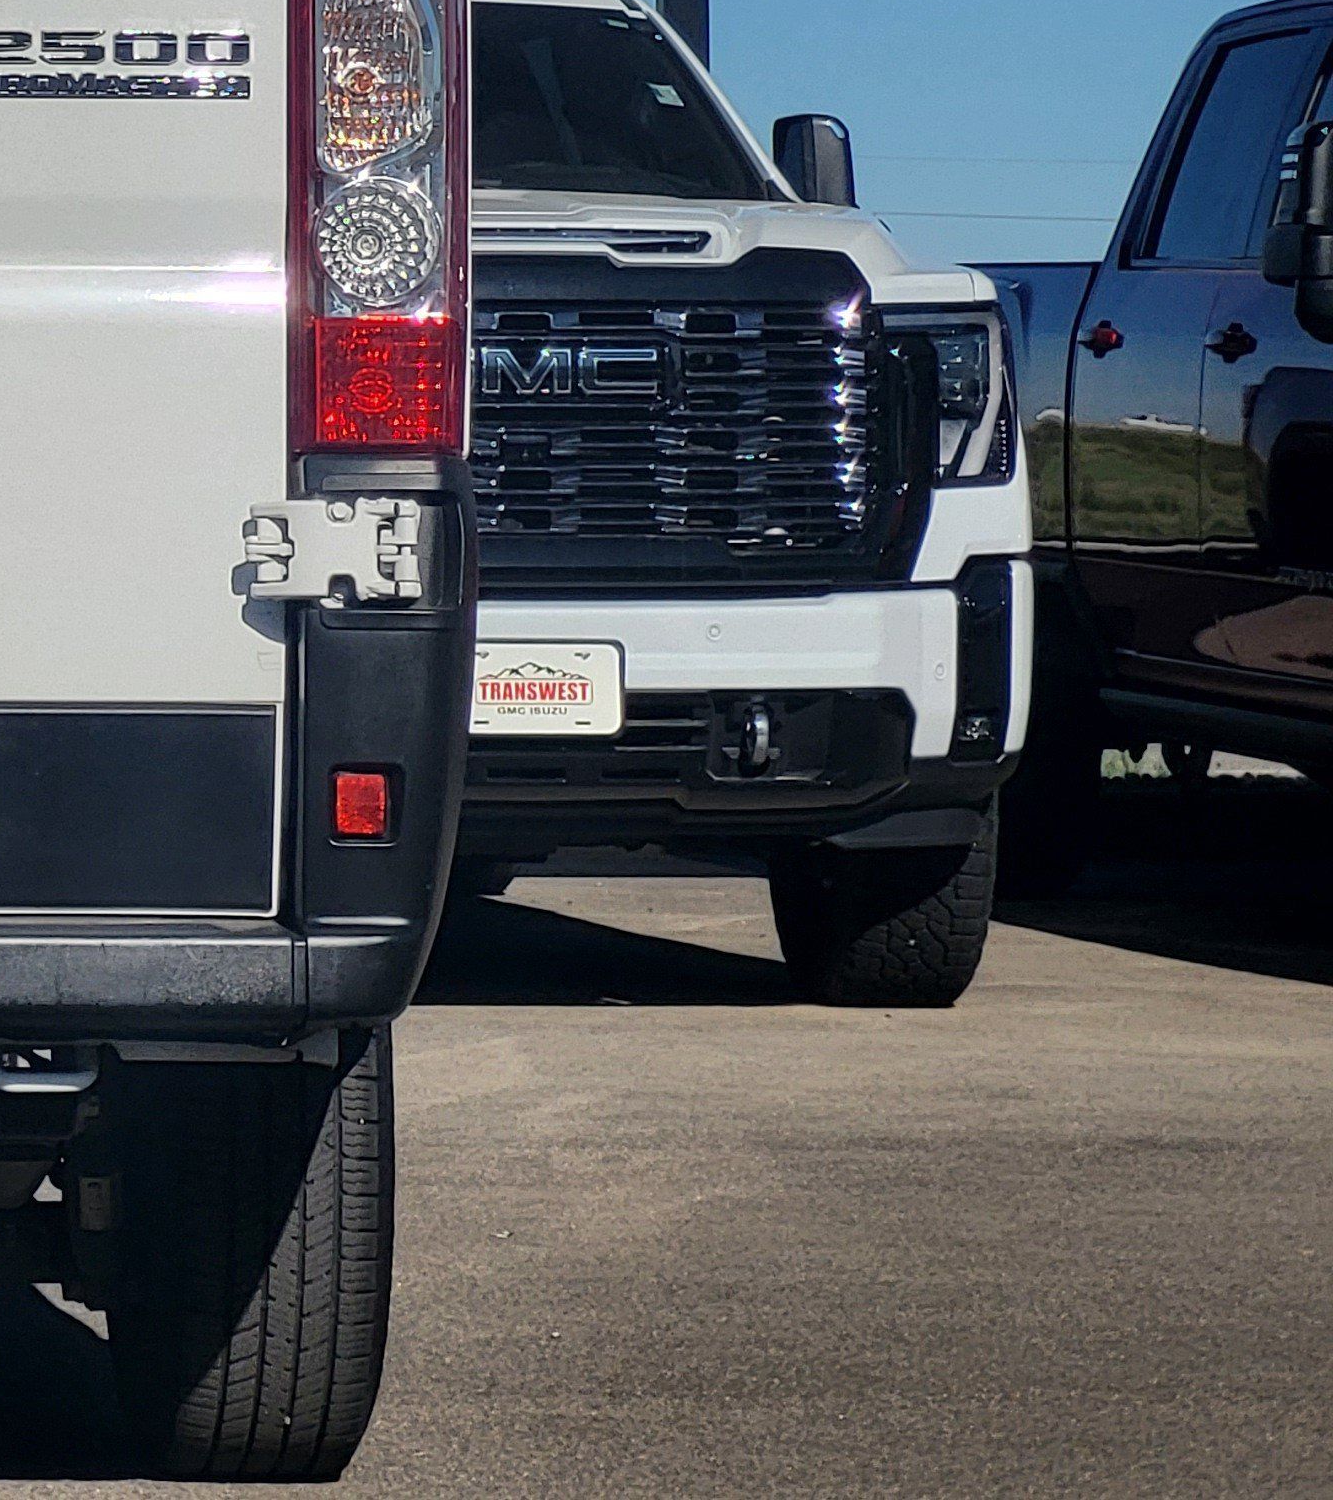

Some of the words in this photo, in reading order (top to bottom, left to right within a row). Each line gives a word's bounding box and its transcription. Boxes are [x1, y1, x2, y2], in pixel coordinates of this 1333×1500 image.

[470, 347, 658, 395] MC
[478, 681, 590, 701] TRANSWEST
[497, 706, 526, 715] GMC
[530, 706, 568, 716] ISUZU
